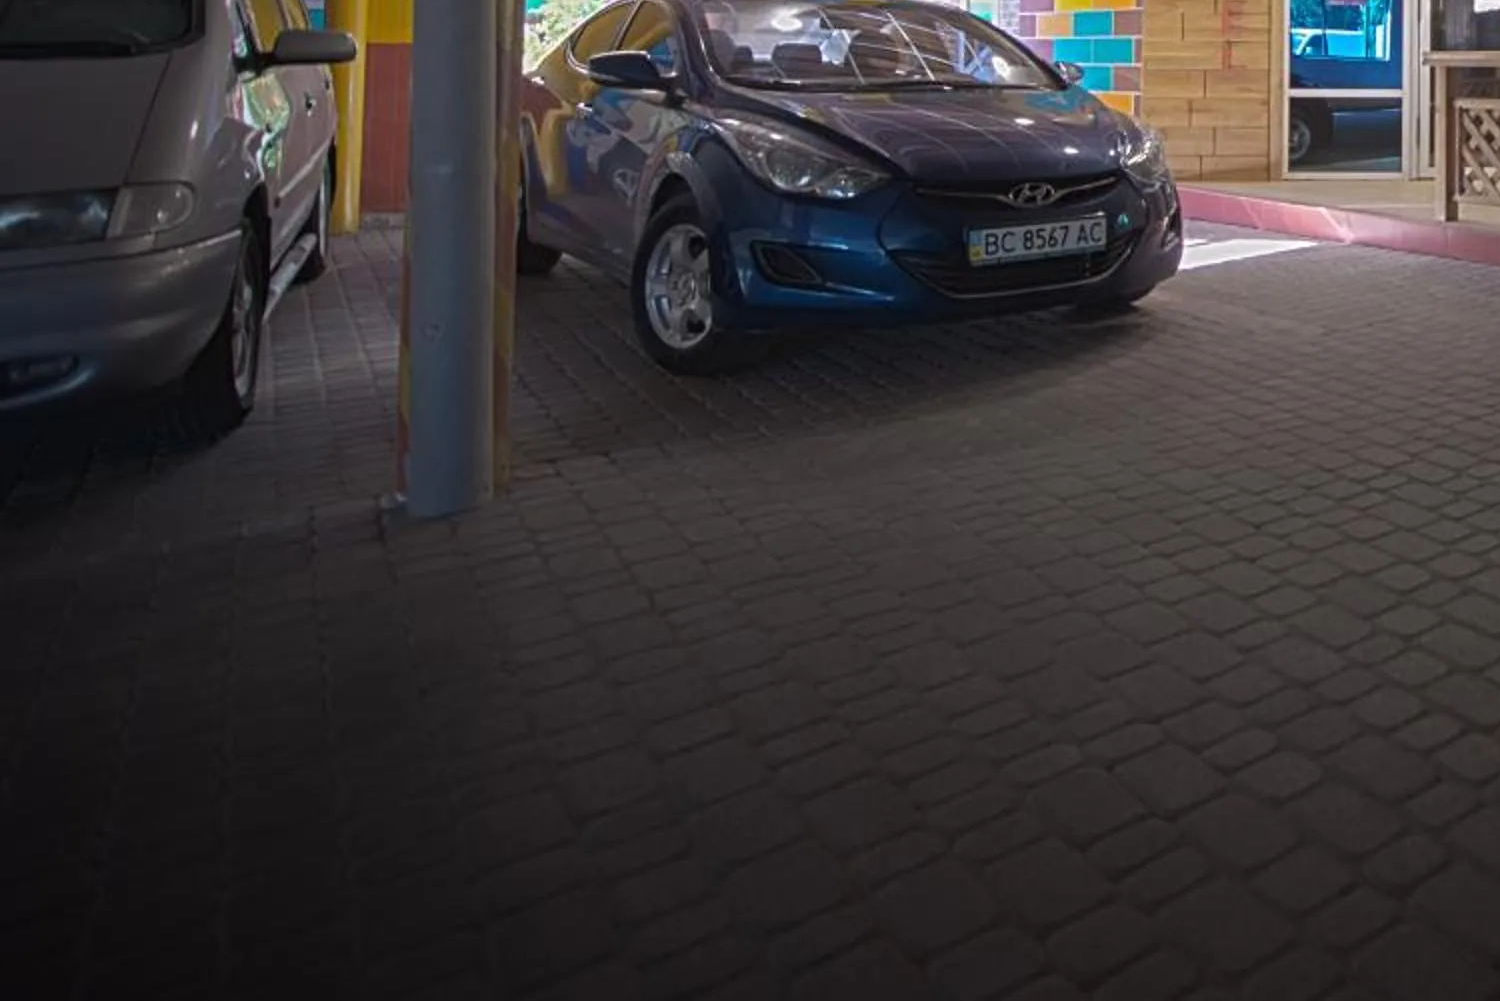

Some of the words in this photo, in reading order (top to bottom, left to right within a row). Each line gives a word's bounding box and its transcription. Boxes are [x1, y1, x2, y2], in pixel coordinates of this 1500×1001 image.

[984, 231, 1016, 256] BC
[1022, 226, 1069, 250] 8567
[1077, 222, 1102, 245] AC
